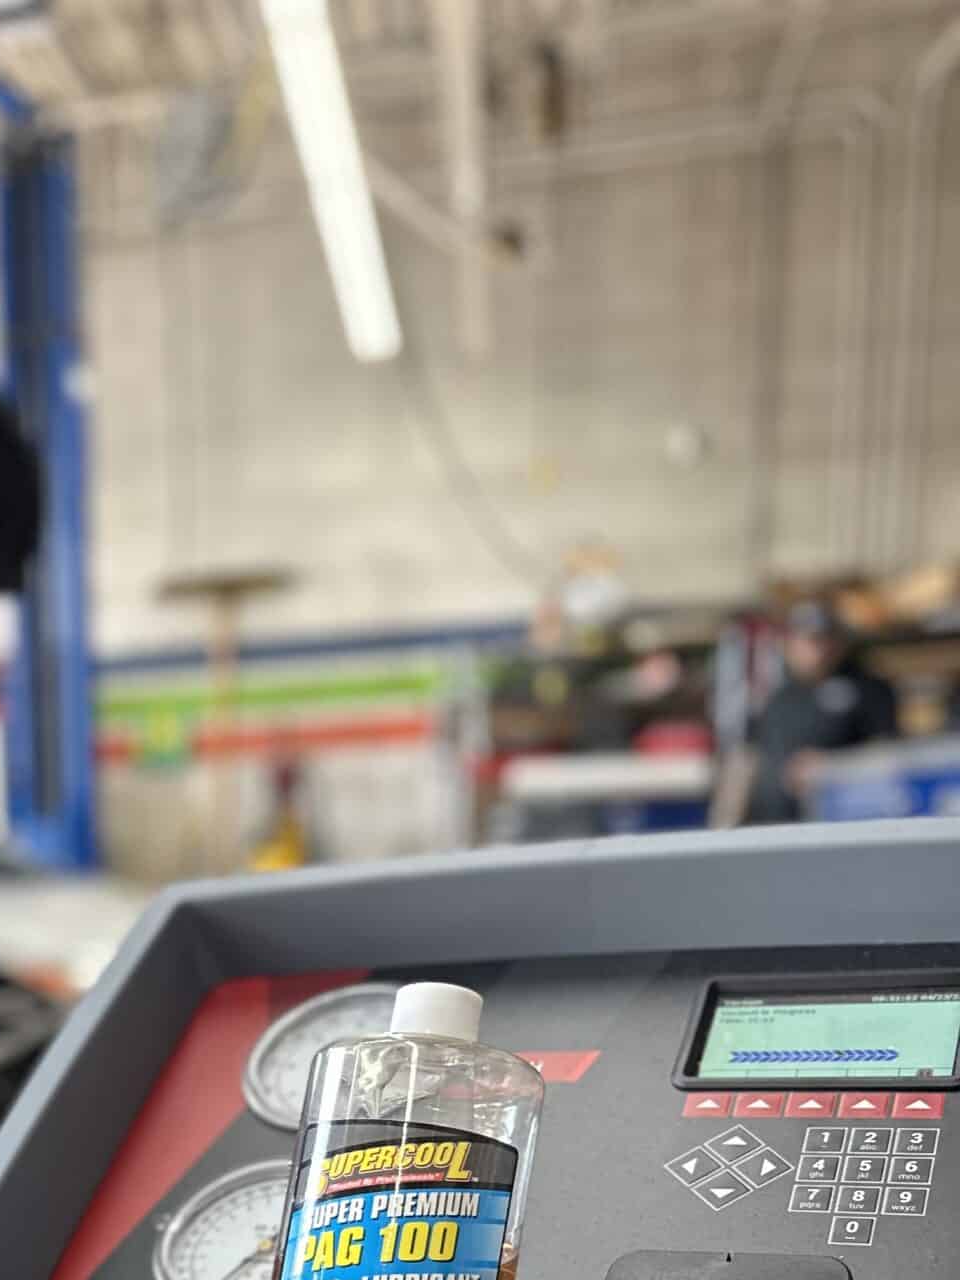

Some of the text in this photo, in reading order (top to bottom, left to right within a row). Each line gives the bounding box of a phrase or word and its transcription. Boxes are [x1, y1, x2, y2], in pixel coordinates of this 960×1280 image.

[821, 1132, 831, 1143] 1
[863, 1131, 878, 1144] 2
[909, 1132, 924, 1144] 3
[314, 1141, 473, 1195] SUPERCOOL
[811, 1159, 825, 1171] 4
[858, 1160, 873, 1172] 5
[904, 1160, 919, 1173] 6
[807, 1188, 820, 1201] 7
[852, 1190, 866, 1202] 8
[899, 1191, 913, 1203] 9
[370, 1191, 481, 1220] PREMIUM
[845, 1220, 860, 1233] 0
[301, 1221, 460, 1272] PAG 100
